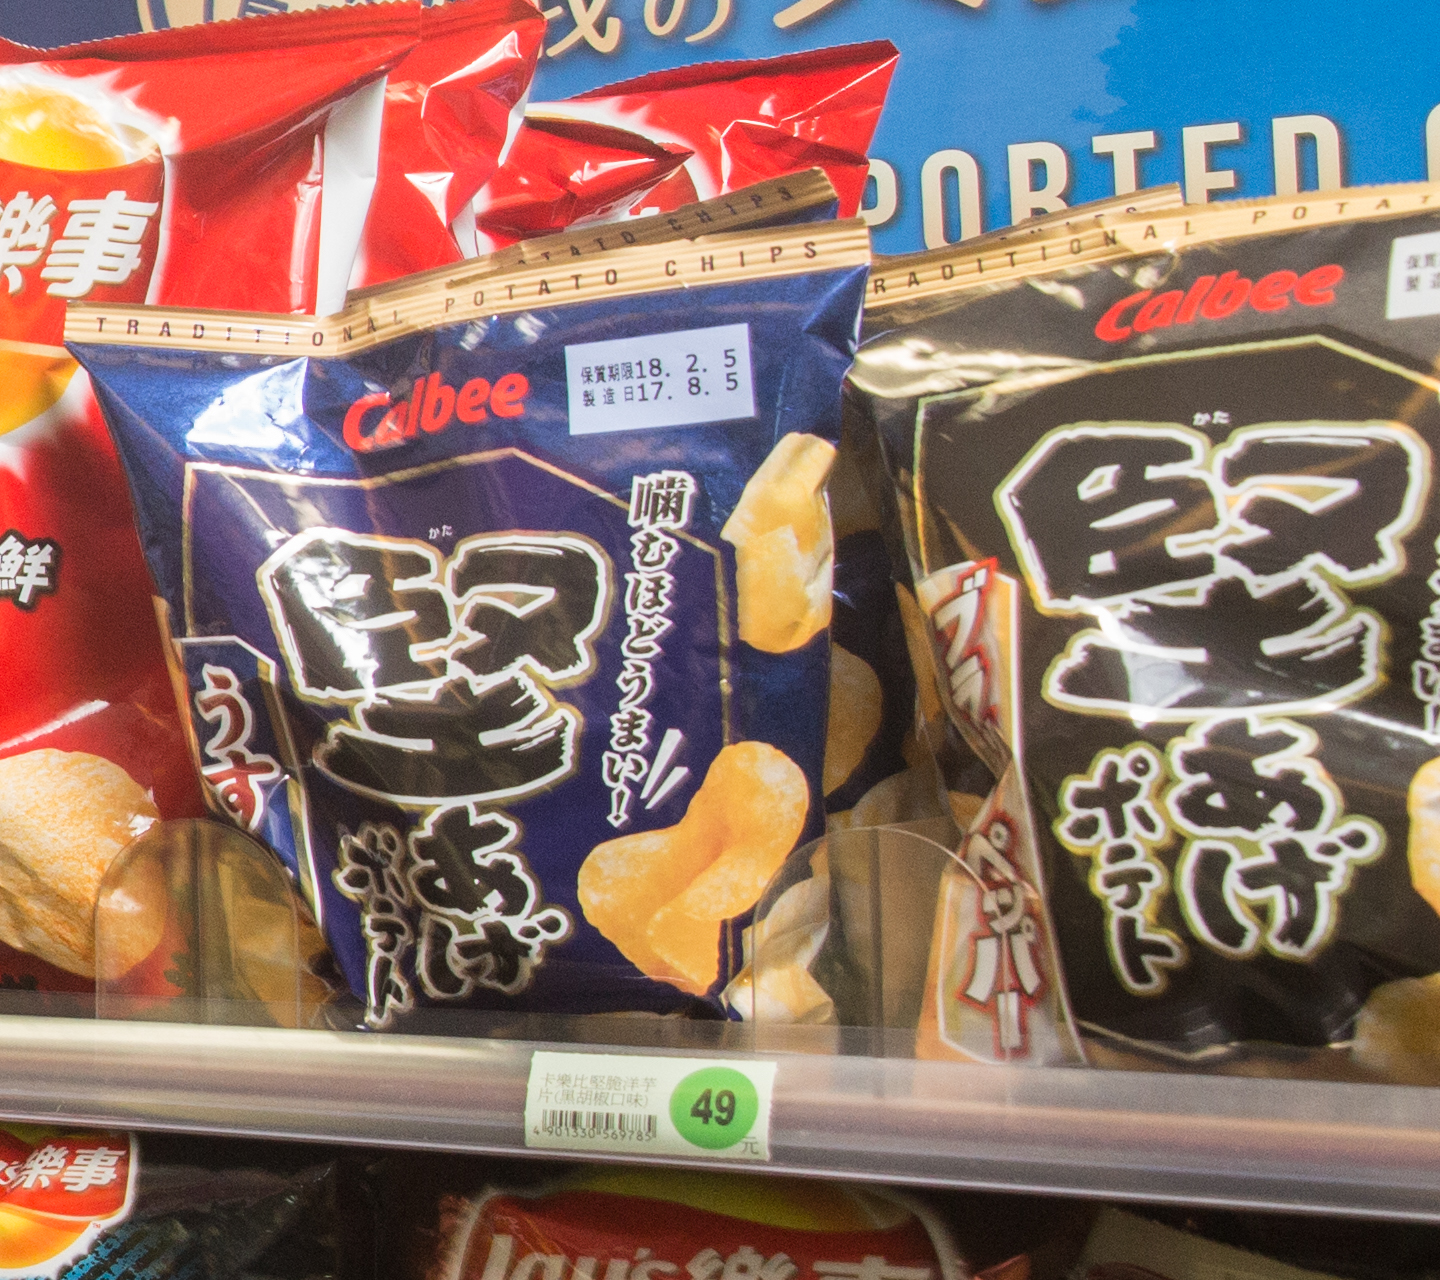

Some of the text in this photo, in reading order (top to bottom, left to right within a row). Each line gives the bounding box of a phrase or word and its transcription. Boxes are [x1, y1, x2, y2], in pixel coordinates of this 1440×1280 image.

[858, 115, 1342, 251] PORTED
[96, 239, 819, 348] TRADITIONAL POTATO CHIPS
[874, 220, 1196, 294] RADITIONAL
[1094, 263, 1346, 343] Calbee
[723, 348, 738, 370] 5
[725, 371, 740, 393] 5
[341, 371, 530, 452] Calbee
[690, 1087, 737, 1127] 49
[742, 1135, 760, 1155] 元
